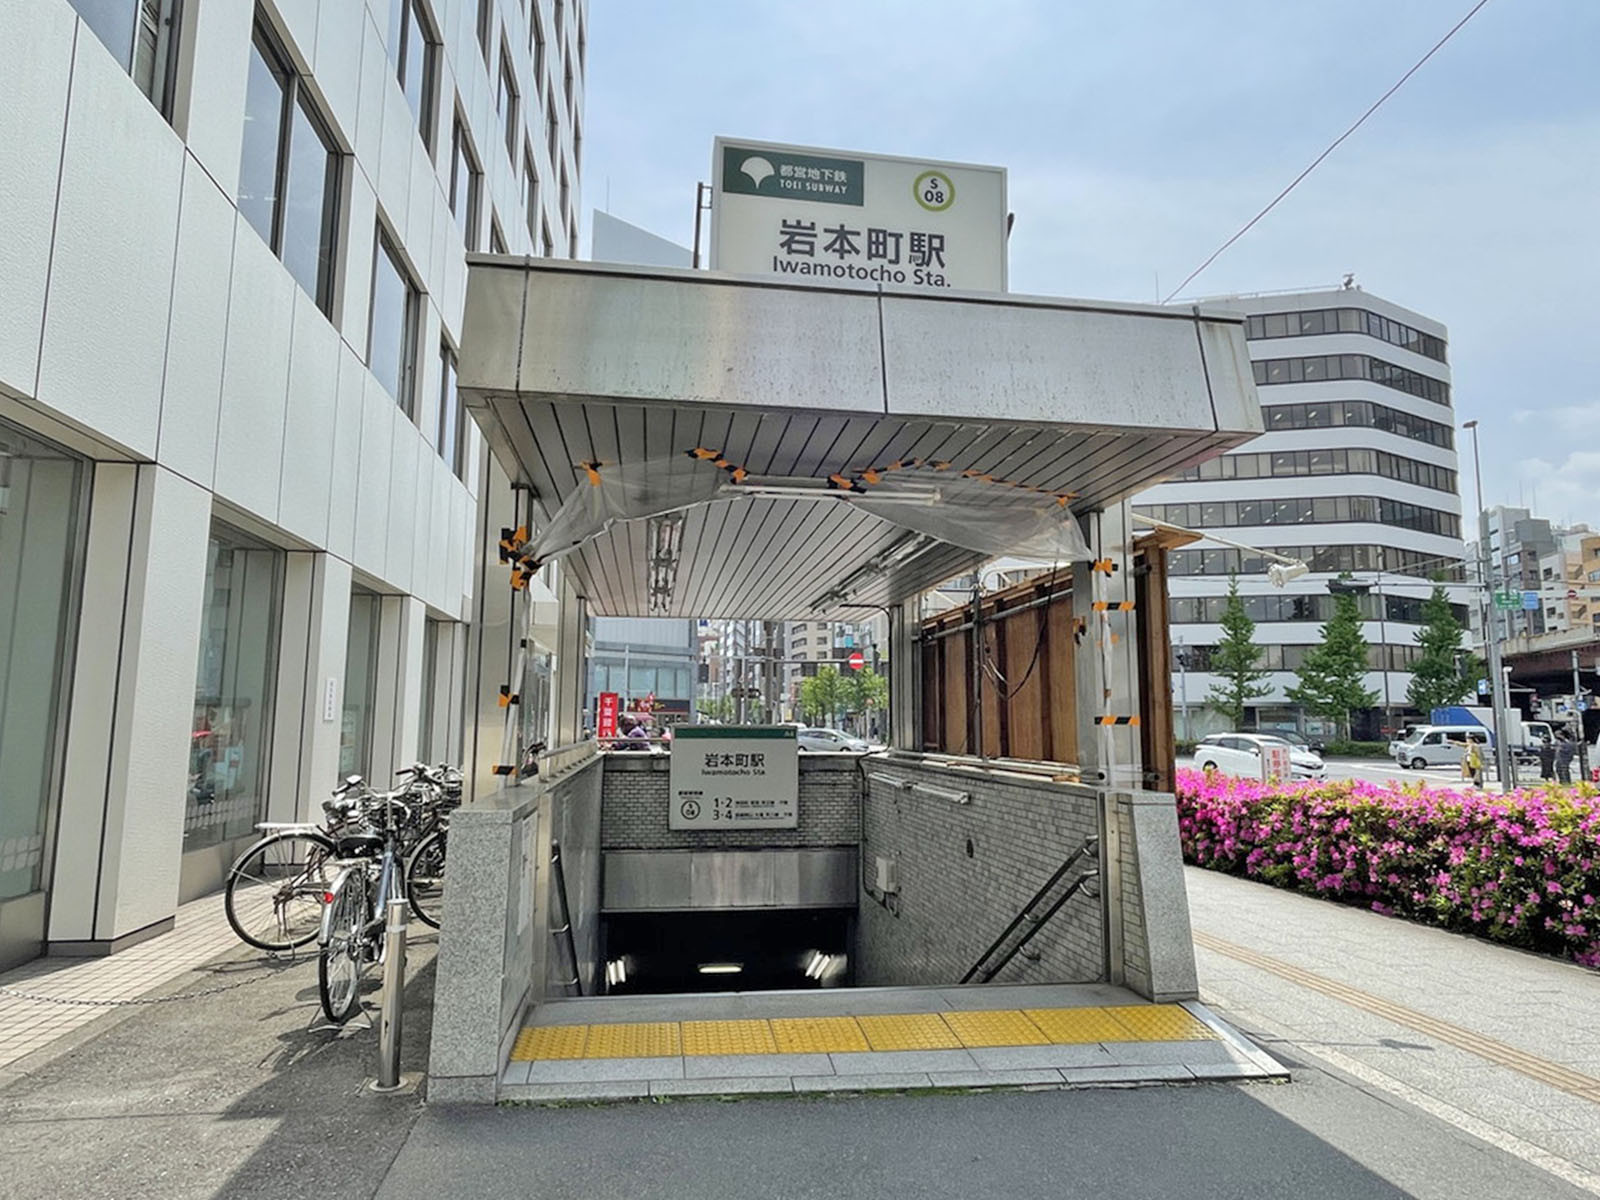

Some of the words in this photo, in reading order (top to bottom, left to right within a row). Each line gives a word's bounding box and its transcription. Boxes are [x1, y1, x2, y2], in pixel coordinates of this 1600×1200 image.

[780, 164, 848, 184] 都営地下鉄
[780, 179, 802, 190] TOEI
[806, 182, 848, 195] SUBWAY
[930, 178, 938, 190] S
[924, 190, 944, 204] 08
[779, 219, 946, 269] 岩本町駅
[773, 255, 906, 284] Iwamotocho
[913, 268, 951, 288] Sta.
[705, 753, 765, 768] 岩本町駅
